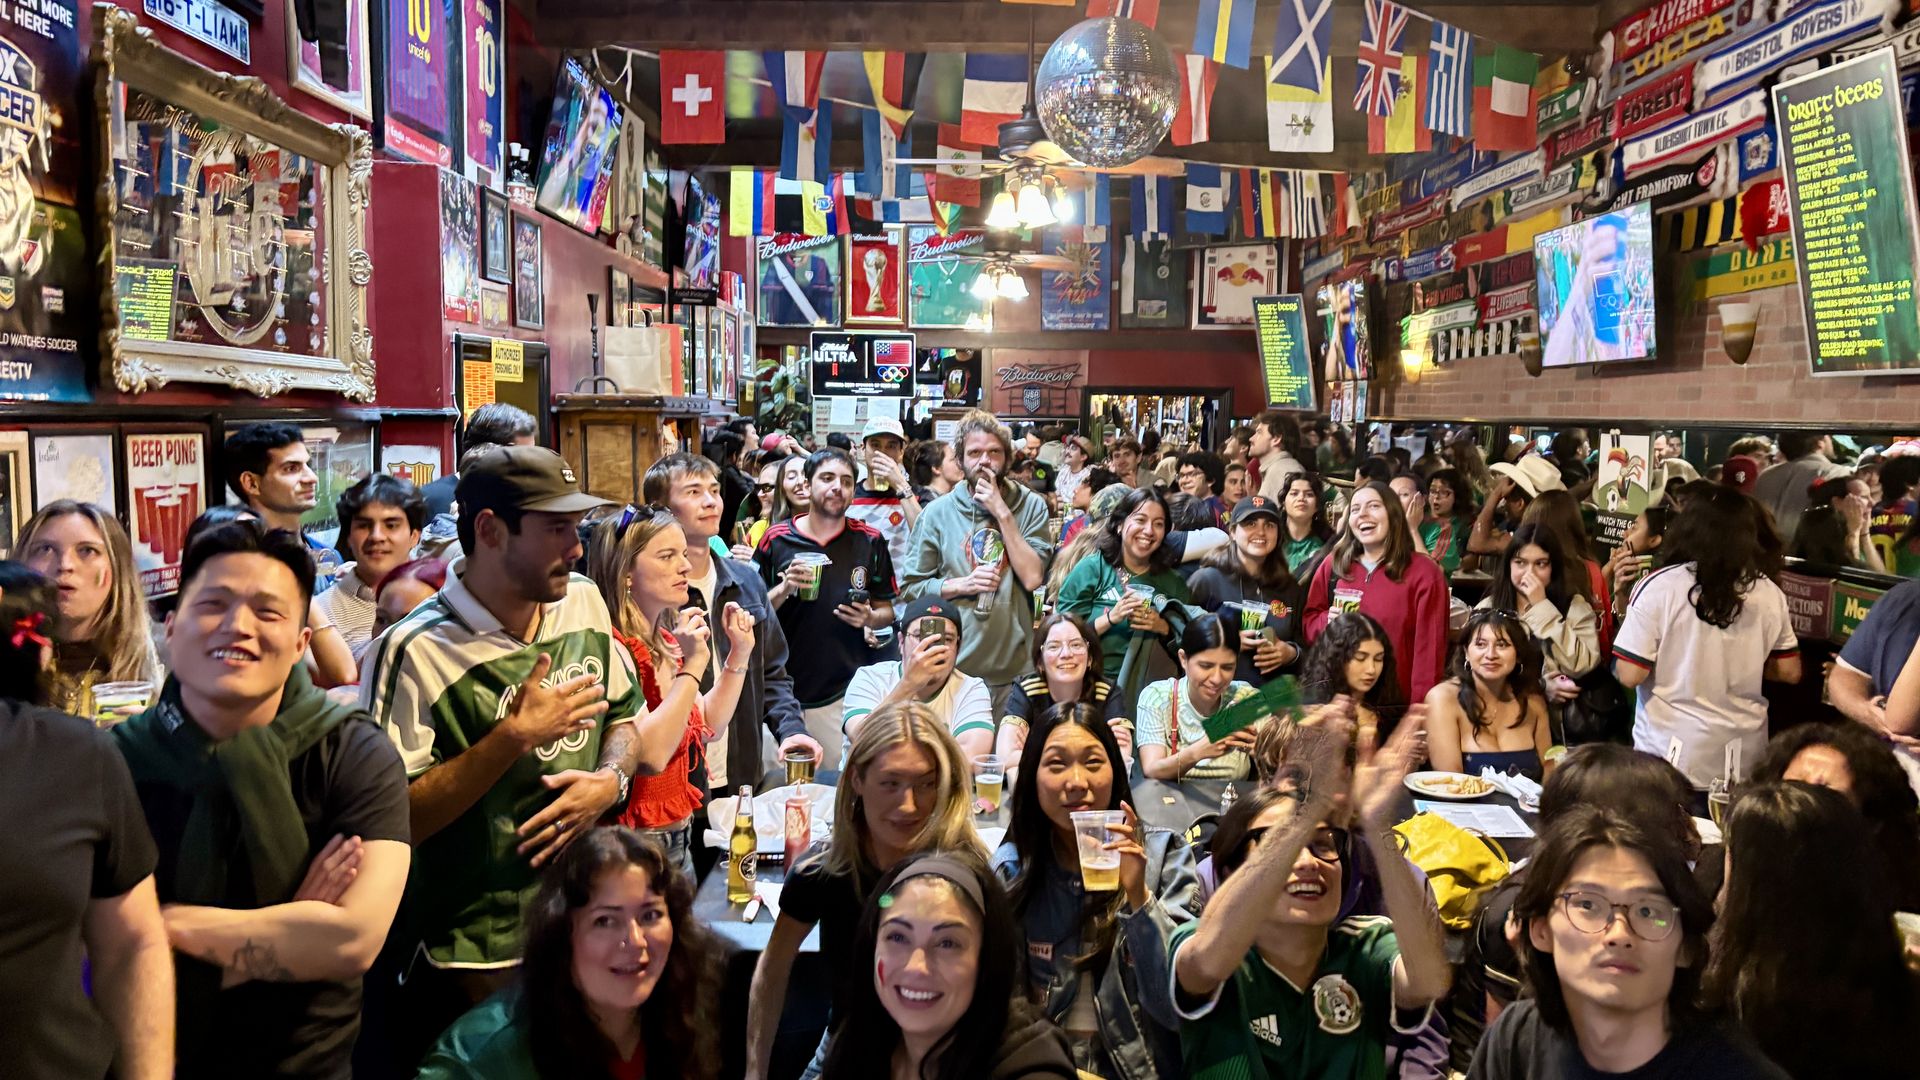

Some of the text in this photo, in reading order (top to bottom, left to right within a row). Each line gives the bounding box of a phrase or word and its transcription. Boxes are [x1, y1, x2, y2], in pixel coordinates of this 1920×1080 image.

[14, 6, 55, 39] HERE.
[41, 0, 74, 29] MORE
[1735, 6, 1843, 71] BRISTOL ROVERS
[475, 25, 496, 98] 10
[0, 86, 35, 127] CER
[1654, 125, 1693, 152] ALDERSHOT
[1694, 118, 1717, 139] TOWN
[761, 233, 836, 260] Budweiser
[852, 233, 888, 242] Budweiser
[10, 333, 47, 350] WATCHES
[47, 337, 77, 352] SOCCER
[495, 347, 521, 361] AUTHORIZED
[814, 350, 858, 363] ULTRA
[0, 361, 33, 382] ECTV
[998, 366, 1076, 382] Budweiser
[132, 438, 197, 468] BEER PONG
[1596, 515, 1627, 529] WATCH THE
[1604, 526, 1616, 537] LIVE
